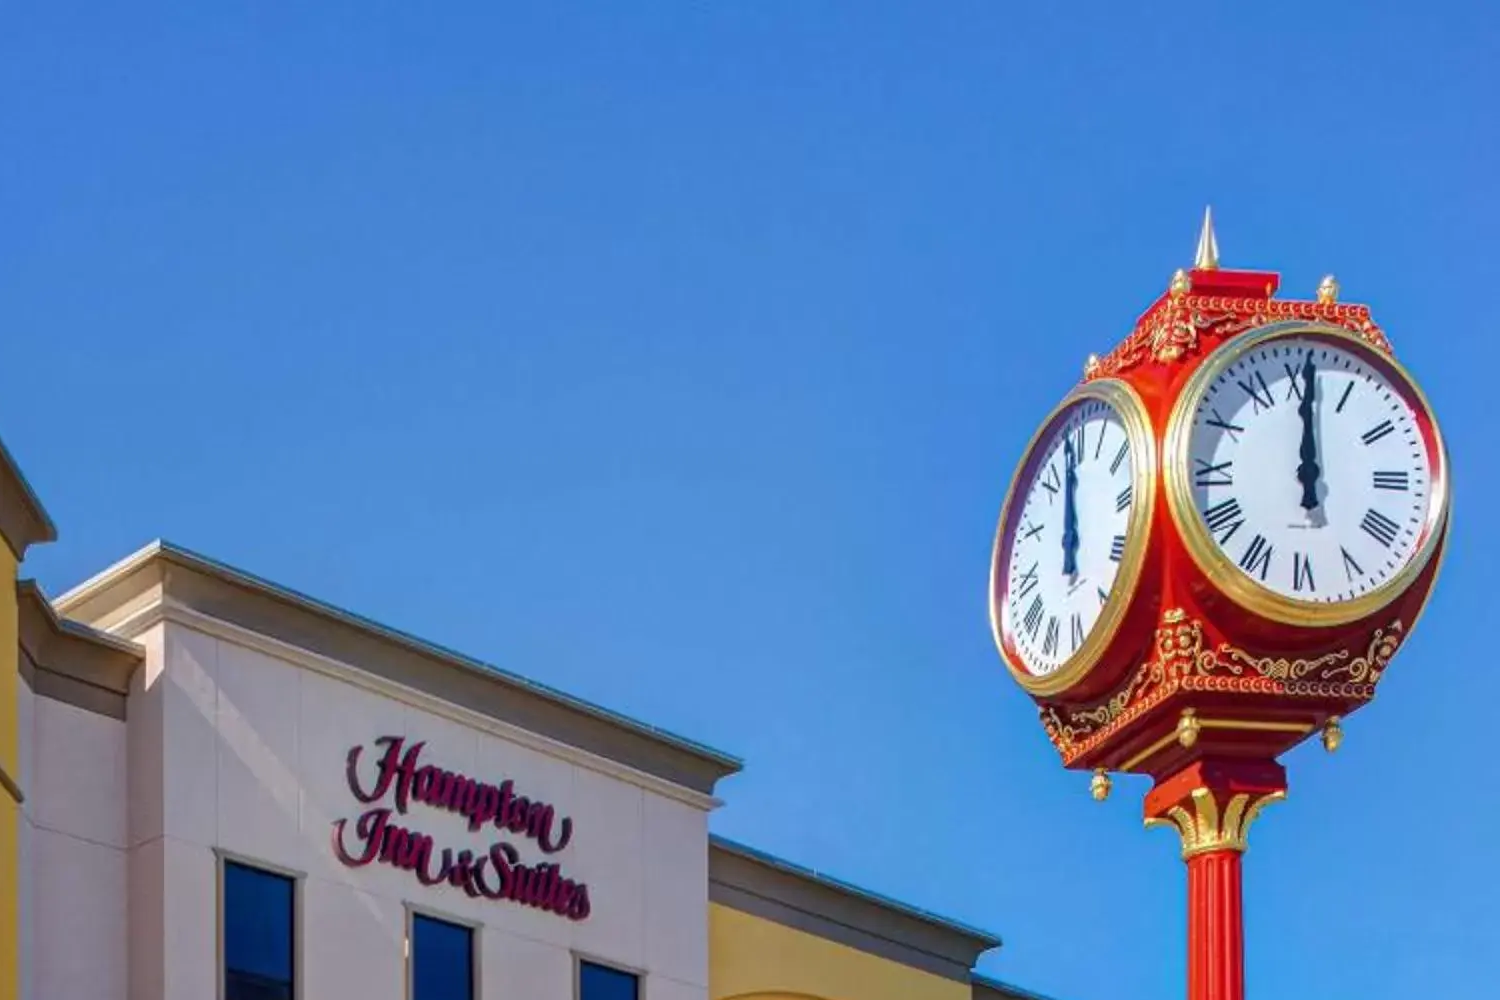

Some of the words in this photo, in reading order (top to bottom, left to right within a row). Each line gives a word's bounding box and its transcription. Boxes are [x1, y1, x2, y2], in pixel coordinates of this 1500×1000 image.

[346, 735, 572, 854] Hampton
[331, 808, 452, 886] Inn
[474, 842, 591, 921] Suites
